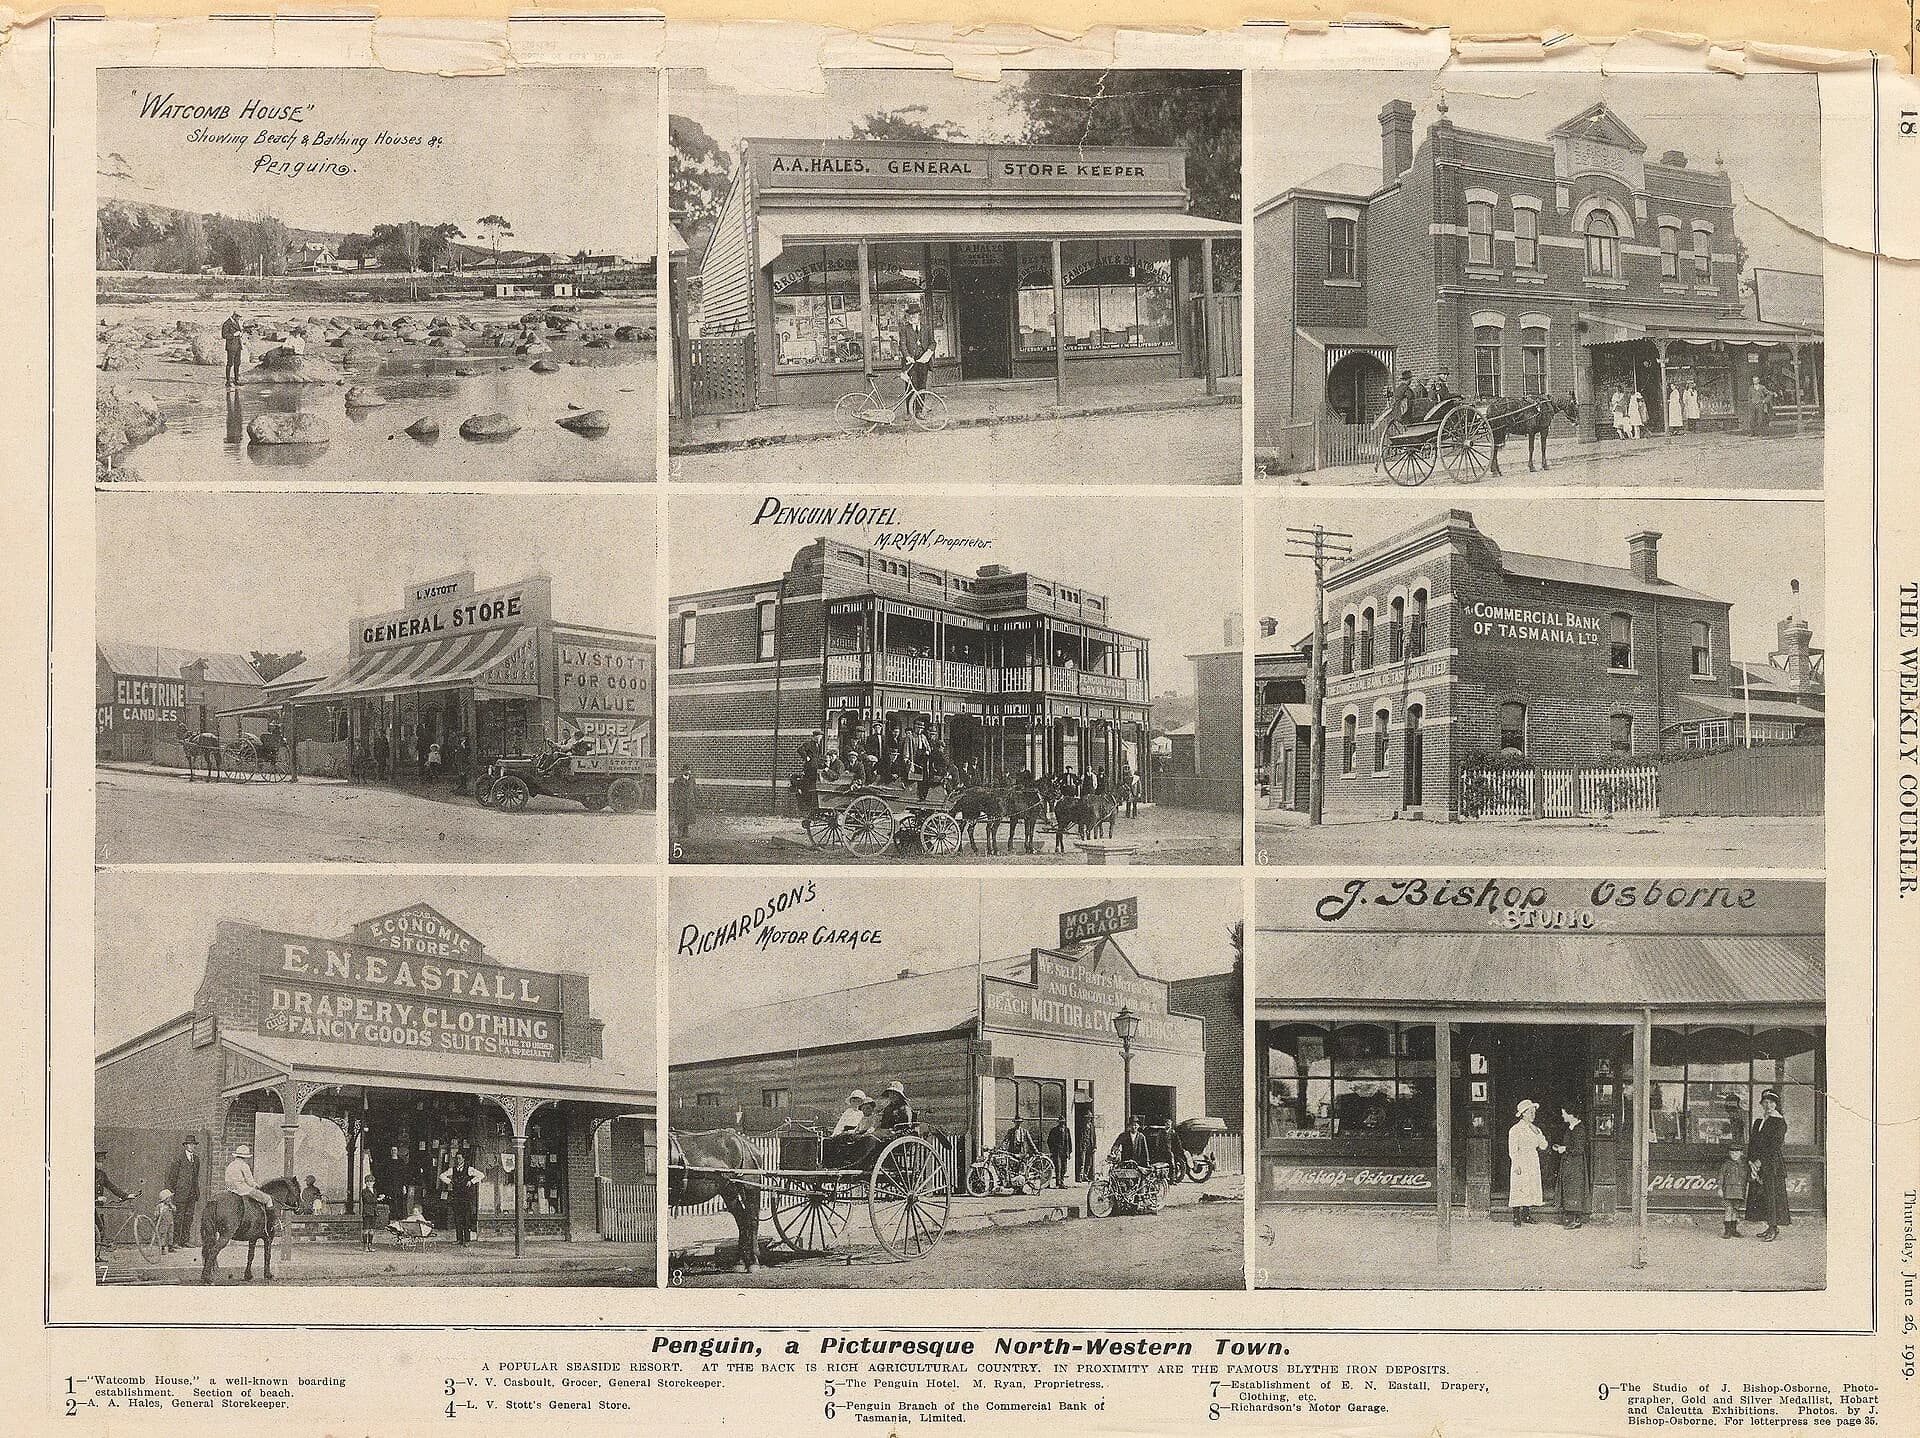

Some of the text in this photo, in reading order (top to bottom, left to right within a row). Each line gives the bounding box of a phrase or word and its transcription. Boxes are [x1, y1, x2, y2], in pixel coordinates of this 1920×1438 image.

[187, 127, 422, 154] Showing Beach & Bathing Houses
[888, 160, 972, 174] GENERAL
[1003, 163, 1068, 176] STORE
[1077, 163, 1145, 177] KEEPER
[750, 497, 838, 525] PENGUIN
[363, 596, 521, 643] GENERAL STORE
[1474, 602, 1600, 631] COMMERCIAL BANK
[1473, 621, 1493, 635] OF
[1498, 623, 1574, 644] TASMANIA
[563, 673, 647, 691] FOR GOOD
[118, 680, 185, 707] ELECTRINE
[579, 696, 635, 712] VALUE
[123, 708, 177, 722] CANDLES
[585, 722, 628, 737] PURE
[1899, 583, 1918, 899] THE WEEKLY COURIER.
[673, 843, 682, 858] 5
[1259, 849, 1268, 865] 6
[1375, 878, 1549, 915] Bishop
[1591, 879, 1757, 909] Osborne
[677, 880, 816, 956] RICHARDSON'S
[1067, 903, 1128, 928] MOTOR
[1503, 909, 1596, 930] STUDIO
[370, 917, 470, 953] ECONOMIC
[1065, 916, 1131, 940] GARAGE
[390, 936, 450, 956] STORE
[755, 925, 882, 952] MOTOR GARAGE
[1031, 996, 1083, 1029] MOTOR
[288, 1015, 498, 1054] FANCY GOODS SUITS
[1902, 1190, 1917, 1263] Thursday,
[673, 1269, 682, 1285] 8
[1901, 1271, 1918, 1306] June
[1902, 1314, 1917, 1335] 26,
[650, 1336, 1290, 1360] Penguin, a Picturesque North-Western Town.
[482, 1362, 1449, 1375] A POPULAR SEASIDE RESORT. AT THE BACK IS RICH AGRICULTURAL COUNTRY. IN PROXIMITY ARE THE FAMOUS BLYTHE IRON DEPOSITS.
[226, 1376, 288, 1385] well-known
[298, 1376, 346, 1387] boarding
[485, 1378, 496, 1388] V.
[562, 1378, 601, 1390] Grocer,
[609, 1378, 650, 1388] General
[658, 1378, 725, 1390] Storekeeper.
[874, 1379, 1104, 1390] Penguin Hotel. M. Ryan, Proprietress.
[1321, 1381, 1331, 1390] of
[1342, 1381, 1353, 1390] E.
[1365, 1381, 1377, 1390] N.
[1441, 1381, 1490, 1392] Drapery,
[1653, 1383, 1879, 1395] Studio of J. Bishop-Osborne, Photo-
[95, 1388, 294, 1397] establishment. Section of beach.
[1239, 1392, 1317, 1403] Clothing, etc.
[1628, 1396, 1879, 1406] grapher, Gold and Silver Medallist, Hobart
[108, 1399, 119, 1408] A.
[172, 1399, 213, 1408] General
[222, 1399, 289, 1410] Storekeeper.
[486, 1401, 497, 1410] V.
[506, 1401, 541, 1410] Stott's
[549, 1401, 591, 1410] General
[898, 1402, 1105, 1411] Branch of the Commercial Bank of
[1309, 1403, 1388, 1414] Motor Garage.
[1628, 1406, 1878, 1417] and Calcutta Exhibitions. Photos. by J.
[855, 1413, 966, 1424] Tasmania, Limited.
[1628, 1417, 1878, 1427] Bishop-Osborne. For letterpress see page 35.
